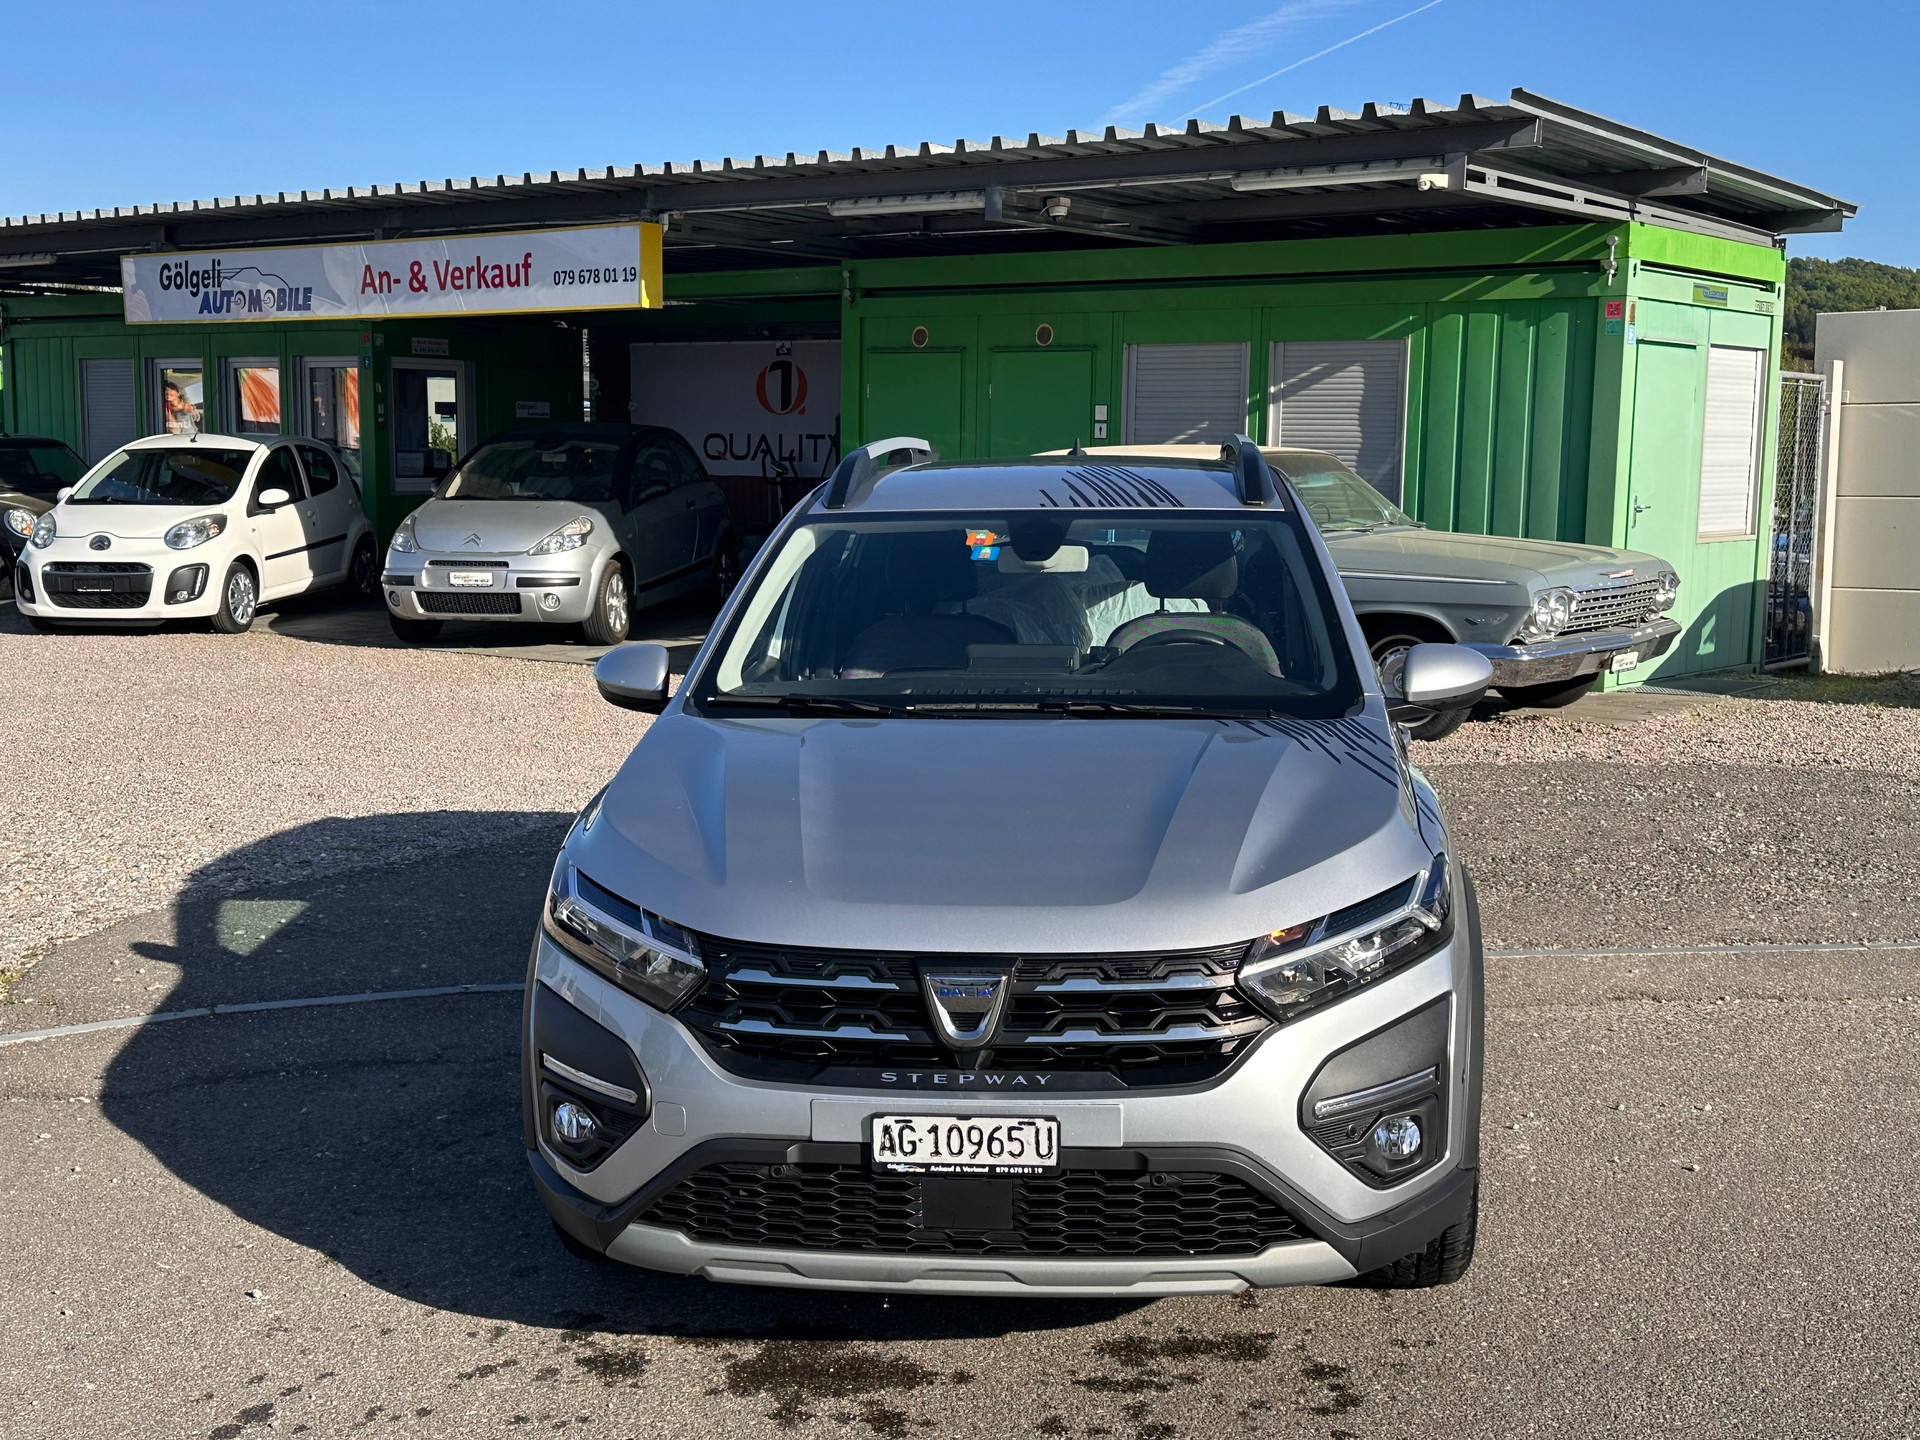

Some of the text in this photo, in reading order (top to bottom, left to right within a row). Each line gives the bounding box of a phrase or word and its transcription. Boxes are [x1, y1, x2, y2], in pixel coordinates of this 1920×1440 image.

[159, 258, 222, 298] Gölgeli
[408, 260, 429, 293] &
[432, 252, 533, 292] Verkauf
[553, 266, 637, 286] 079 678 01 19
[198, 286, 313, 315] AUTOMOBILE
[880, 1072, 1052, 1086] STEPWAY
